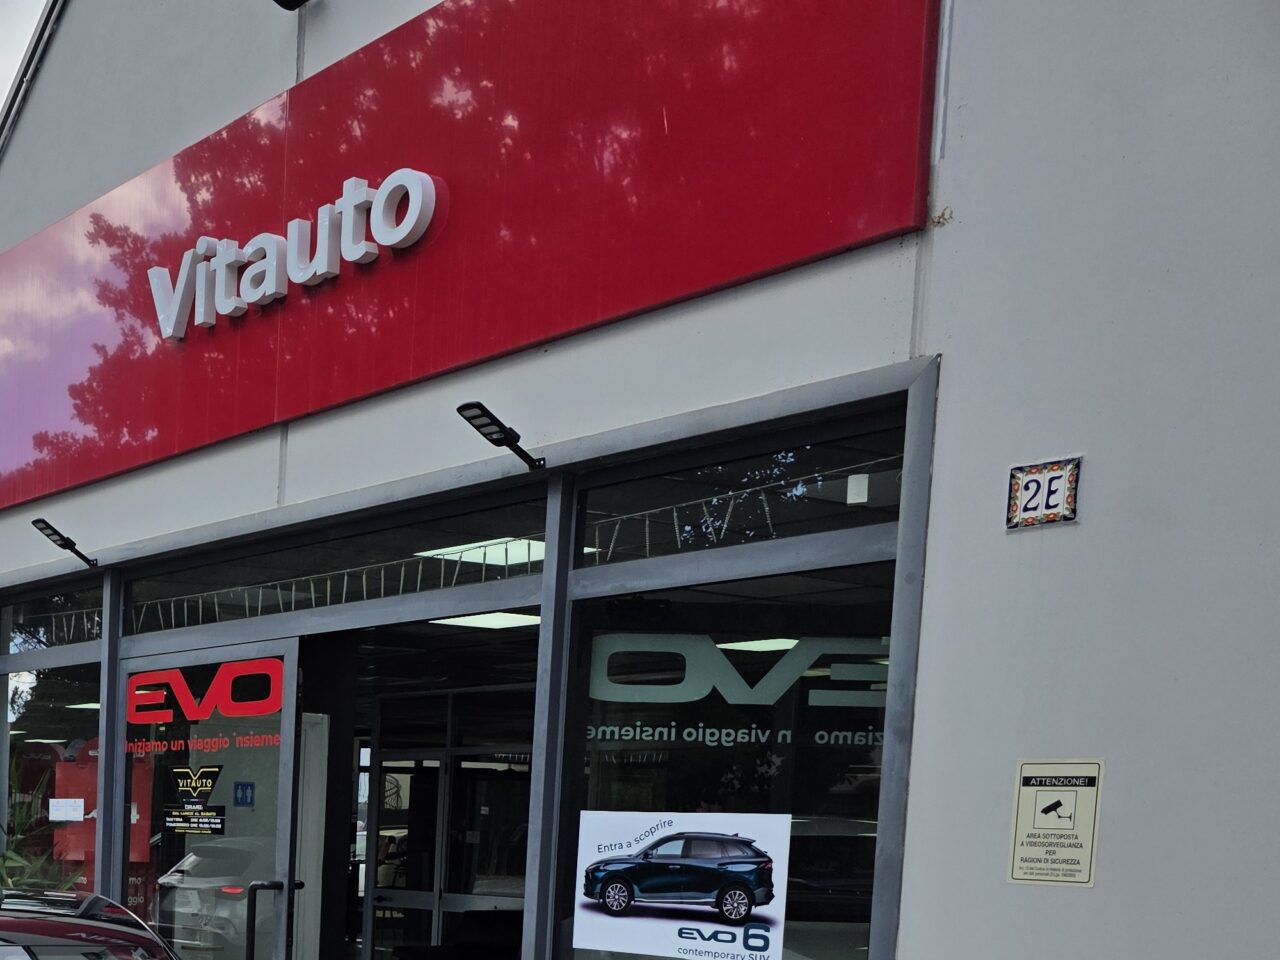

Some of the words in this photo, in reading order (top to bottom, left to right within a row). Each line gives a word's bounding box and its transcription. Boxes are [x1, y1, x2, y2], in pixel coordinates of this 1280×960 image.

[147, 167, 436, 341] Vitauto
[1021, 474, 1064, 513] 2E
[126, 658, 284, 725] EVO
[124, 738, 168, 753] Iniziamo
[170, 739, 185, 751] un
[187, 732, 230, 753] viaggio
[232, 730, 281, 748] nsieme
[177, 778, 213, 788] VITAUTO
[1030, 777, 1088, 786] ATTENZIONE!
[596, 841, 624, 854] Entra
[626, 841, 632, 849] a
[634, 818, 674, 845] scoprire
[1026, 841, 1083, 849] VIDEOSORVEGLIANZA
[1042, 832, 1079, 840] SOTTOPOSTA
[1020, 856, 1043, 864] RAGIONI
[1049, 858, 1081, 866] SICUREZZA
[677, 926, 737, 944] EVO
[742, 923, 771, 952] 6
